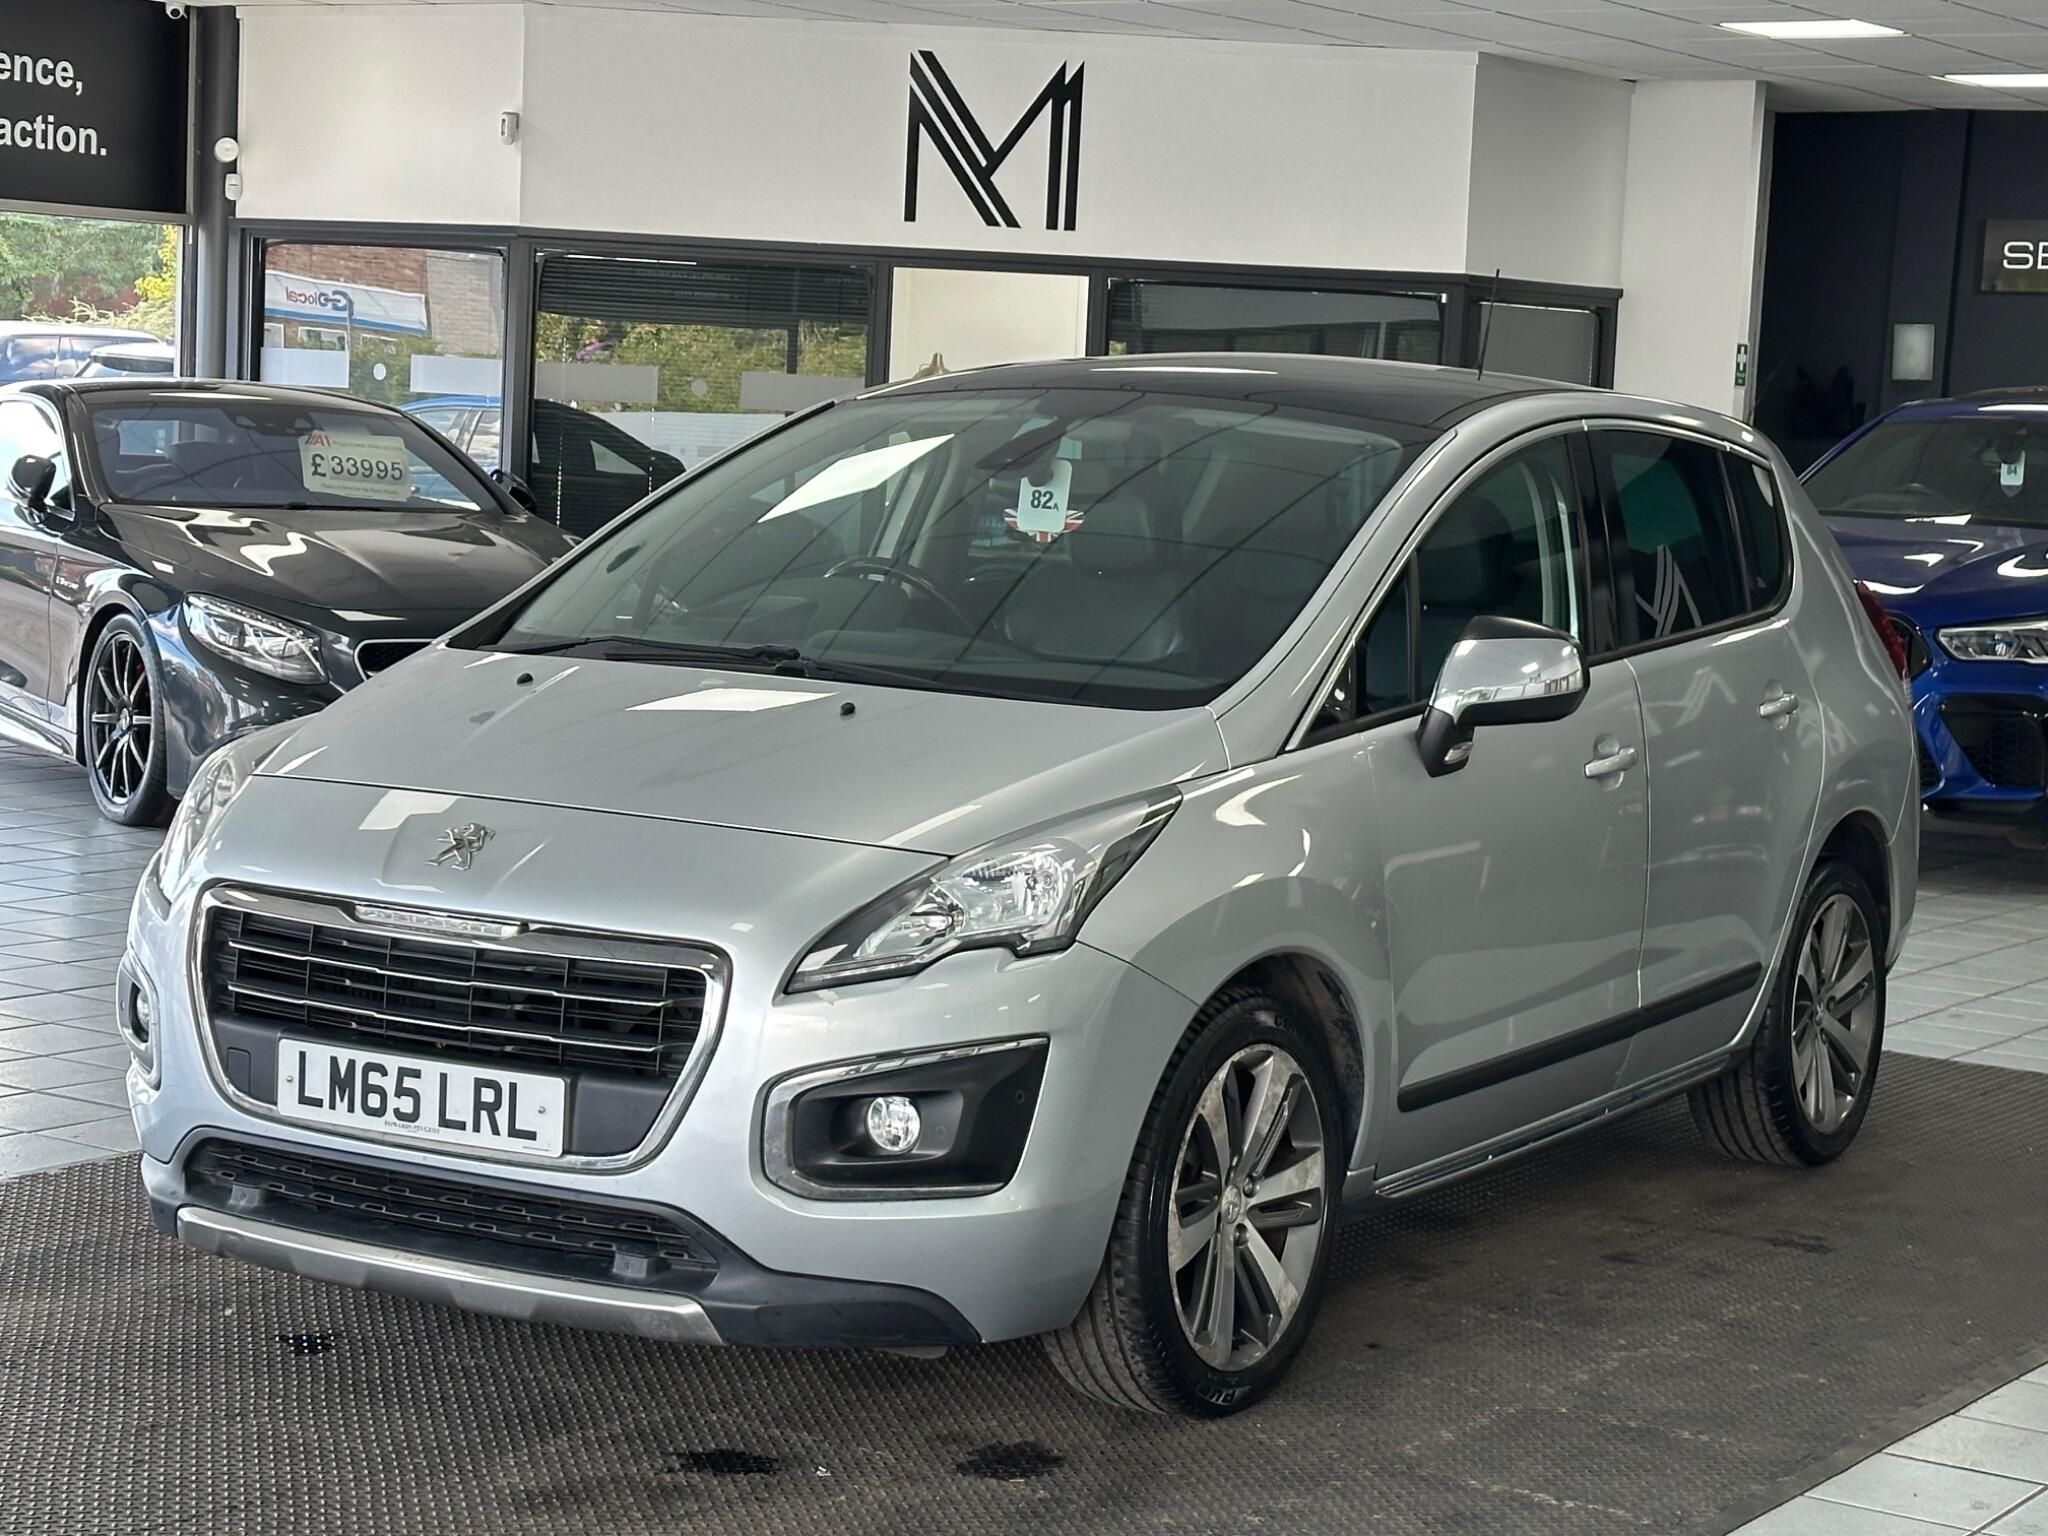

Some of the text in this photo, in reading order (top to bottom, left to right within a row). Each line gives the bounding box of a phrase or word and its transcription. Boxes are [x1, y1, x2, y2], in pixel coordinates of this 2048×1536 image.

[311, 453, 404, 481] £33995
[297, 1051, 537, 1141] LM65 LRL
